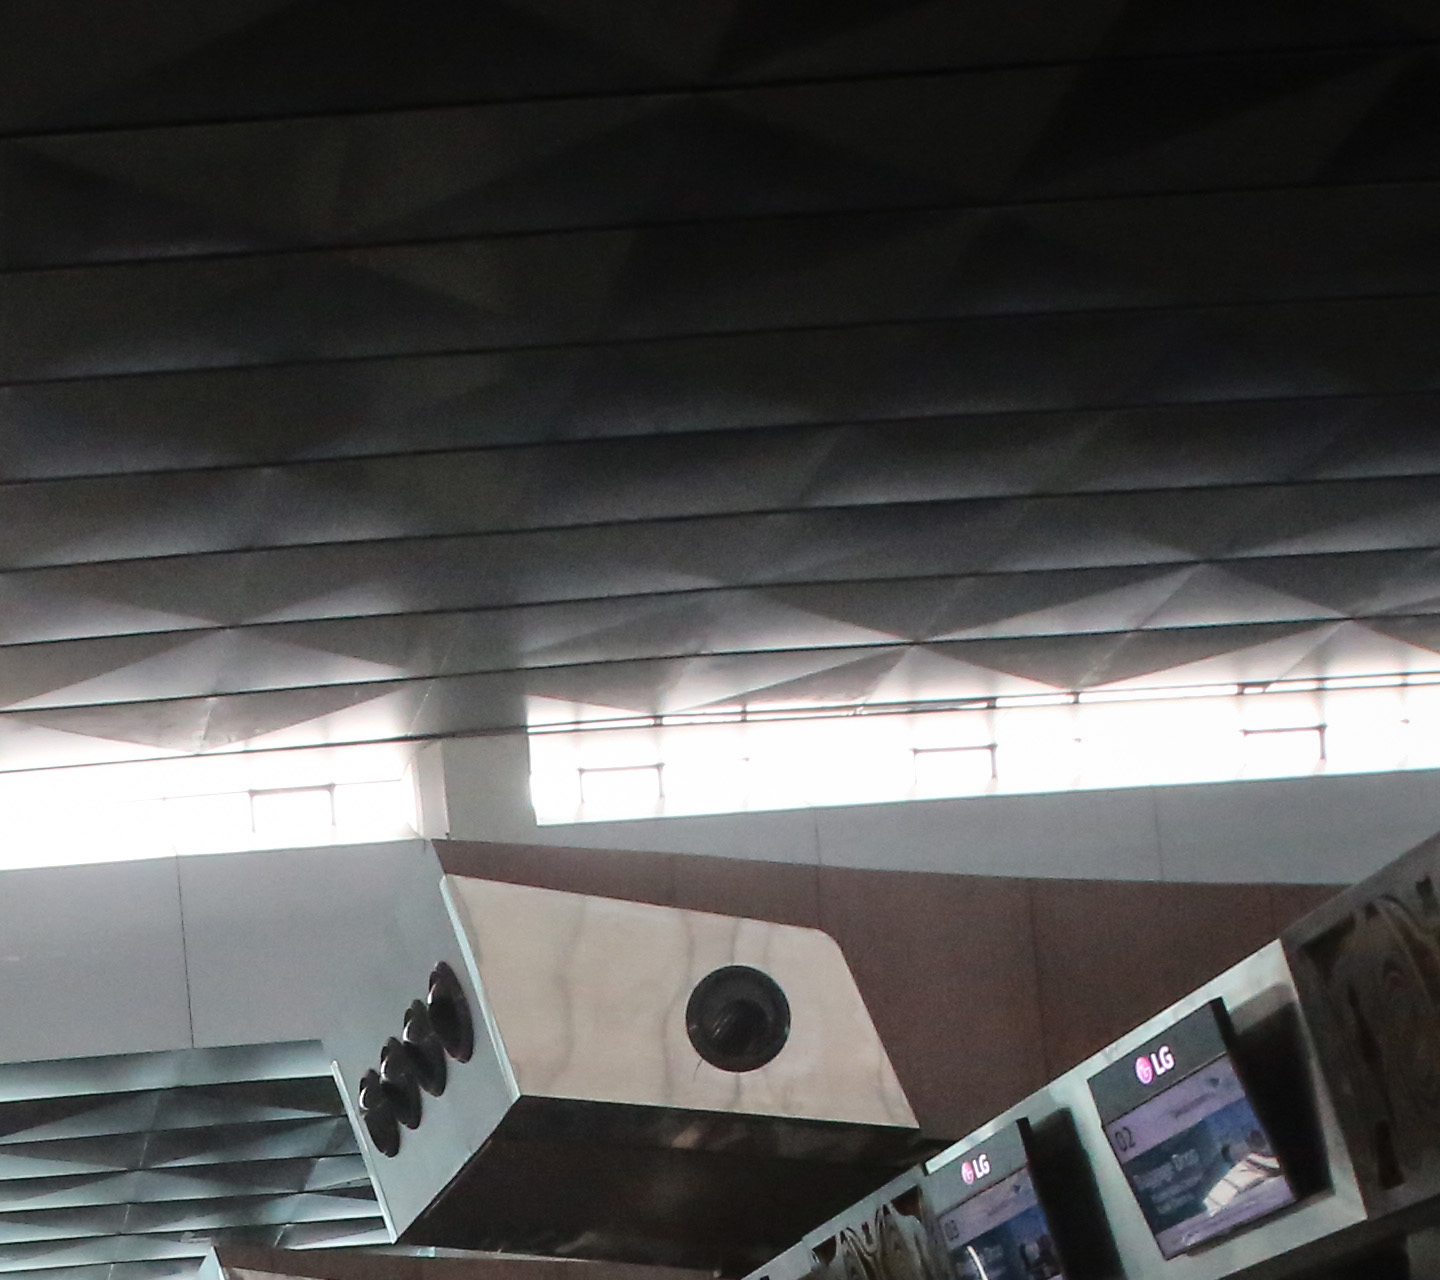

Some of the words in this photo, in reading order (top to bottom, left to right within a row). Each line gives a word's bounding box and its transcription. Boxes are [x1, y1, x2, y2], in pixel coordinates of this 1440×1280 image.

[1150, 1045, 1175, 1076] LG
[1114, 1126, 1136, 1152] 02
[972, 1153, 992, 1179] LG
